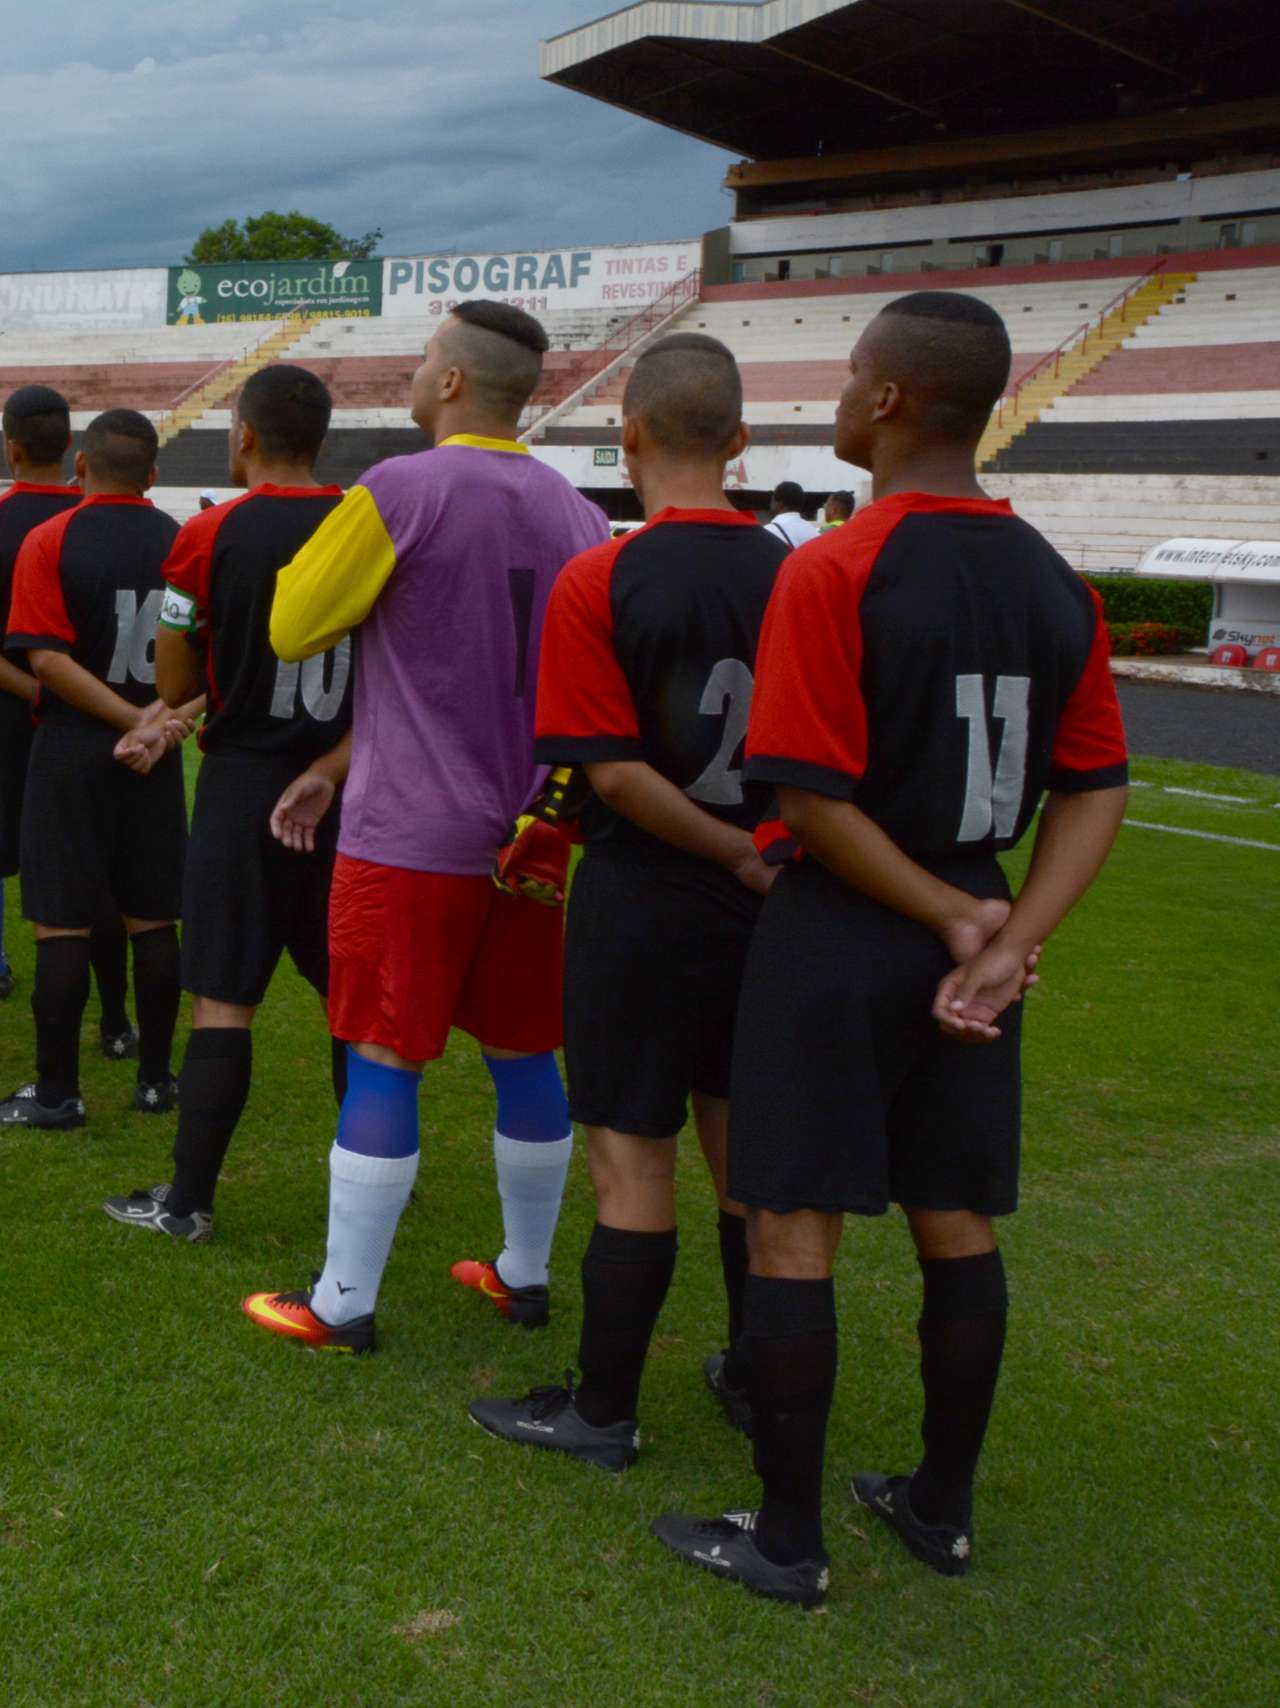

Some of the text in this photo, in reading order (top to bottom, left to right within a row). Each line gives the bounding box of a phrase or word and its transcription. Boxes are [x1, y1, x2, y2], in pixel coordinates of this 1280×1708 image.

[217, 265, 370, 305] ecojardim
[389, 252, 592, 296] PISOGRAF
[605, 256, 688, 276] TINTAS E
[684, 657, 754, 806] 2
[956, 674, 1031, 842] 11
